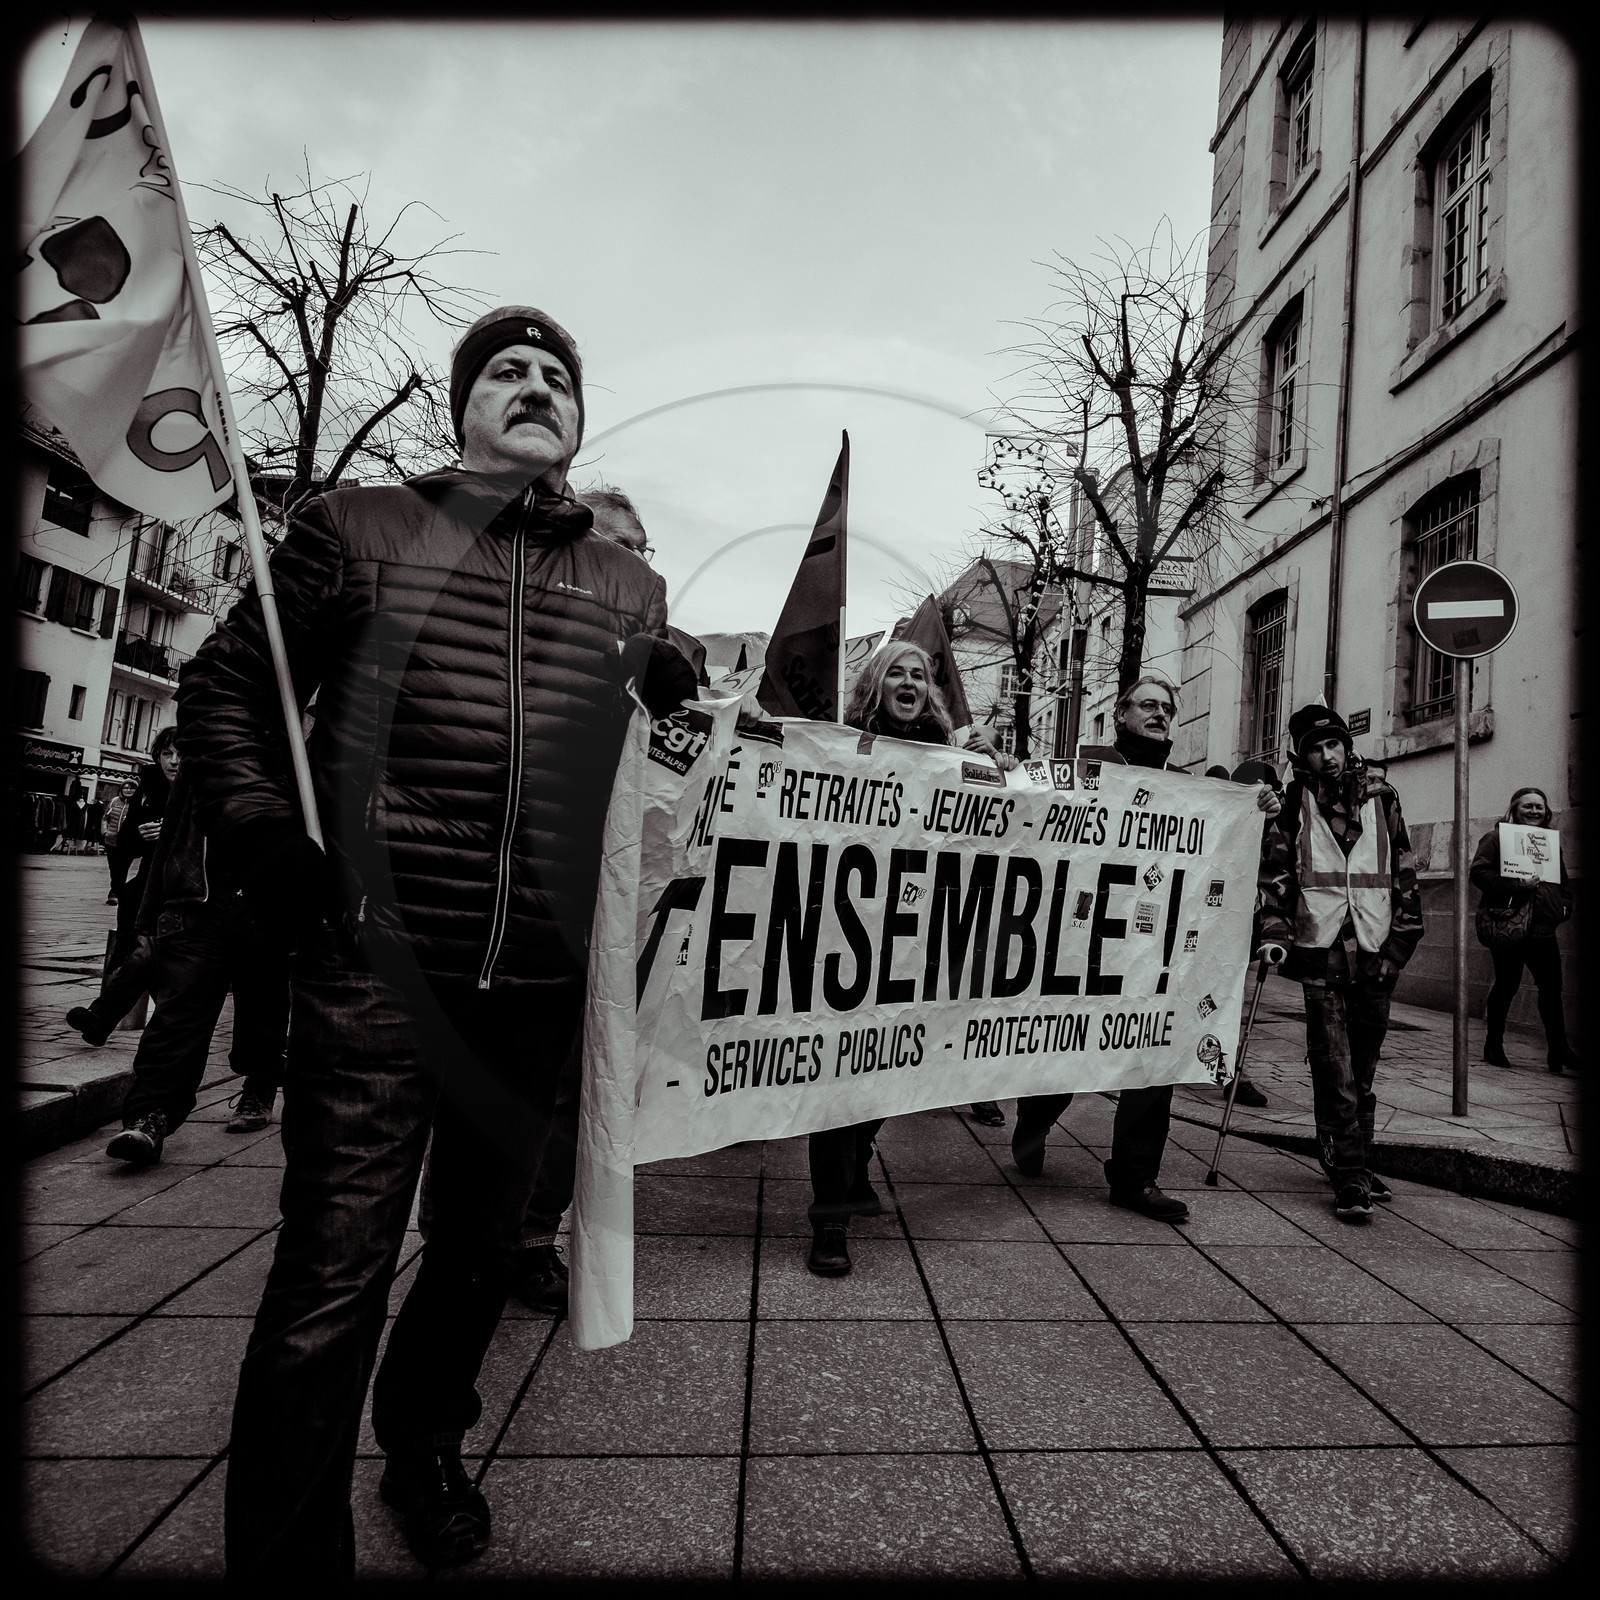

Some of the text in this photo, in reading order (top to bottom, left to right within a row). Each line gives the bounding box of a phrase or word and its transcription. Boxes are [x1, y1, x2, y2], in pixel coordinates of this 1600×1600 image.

[651, 718, 708, 758] cgt
[965, 768, 1001, 783] Solidaires
[1054, 763, 1071, 783] FO
[780, 769, 904, 829] RETRAITÉS
[923, 788, 1016, 837] JEUNES
[1039, 797, 1109, 847] PRIVÉS
[1117, 809, 1205, 856] D'EMPLOI
[1207, 893, 1223, 906] cgt
[701, 837, 1138, 1022] ENSEMBLE
[704, 1033, 824, 1098] SERVICES
[835, 1022, 926, 1078] PUBLICS
[963, 1013, 1090, 1060] PROTECTION
[1099, 1011, 1175, 1051] SOCIALE
